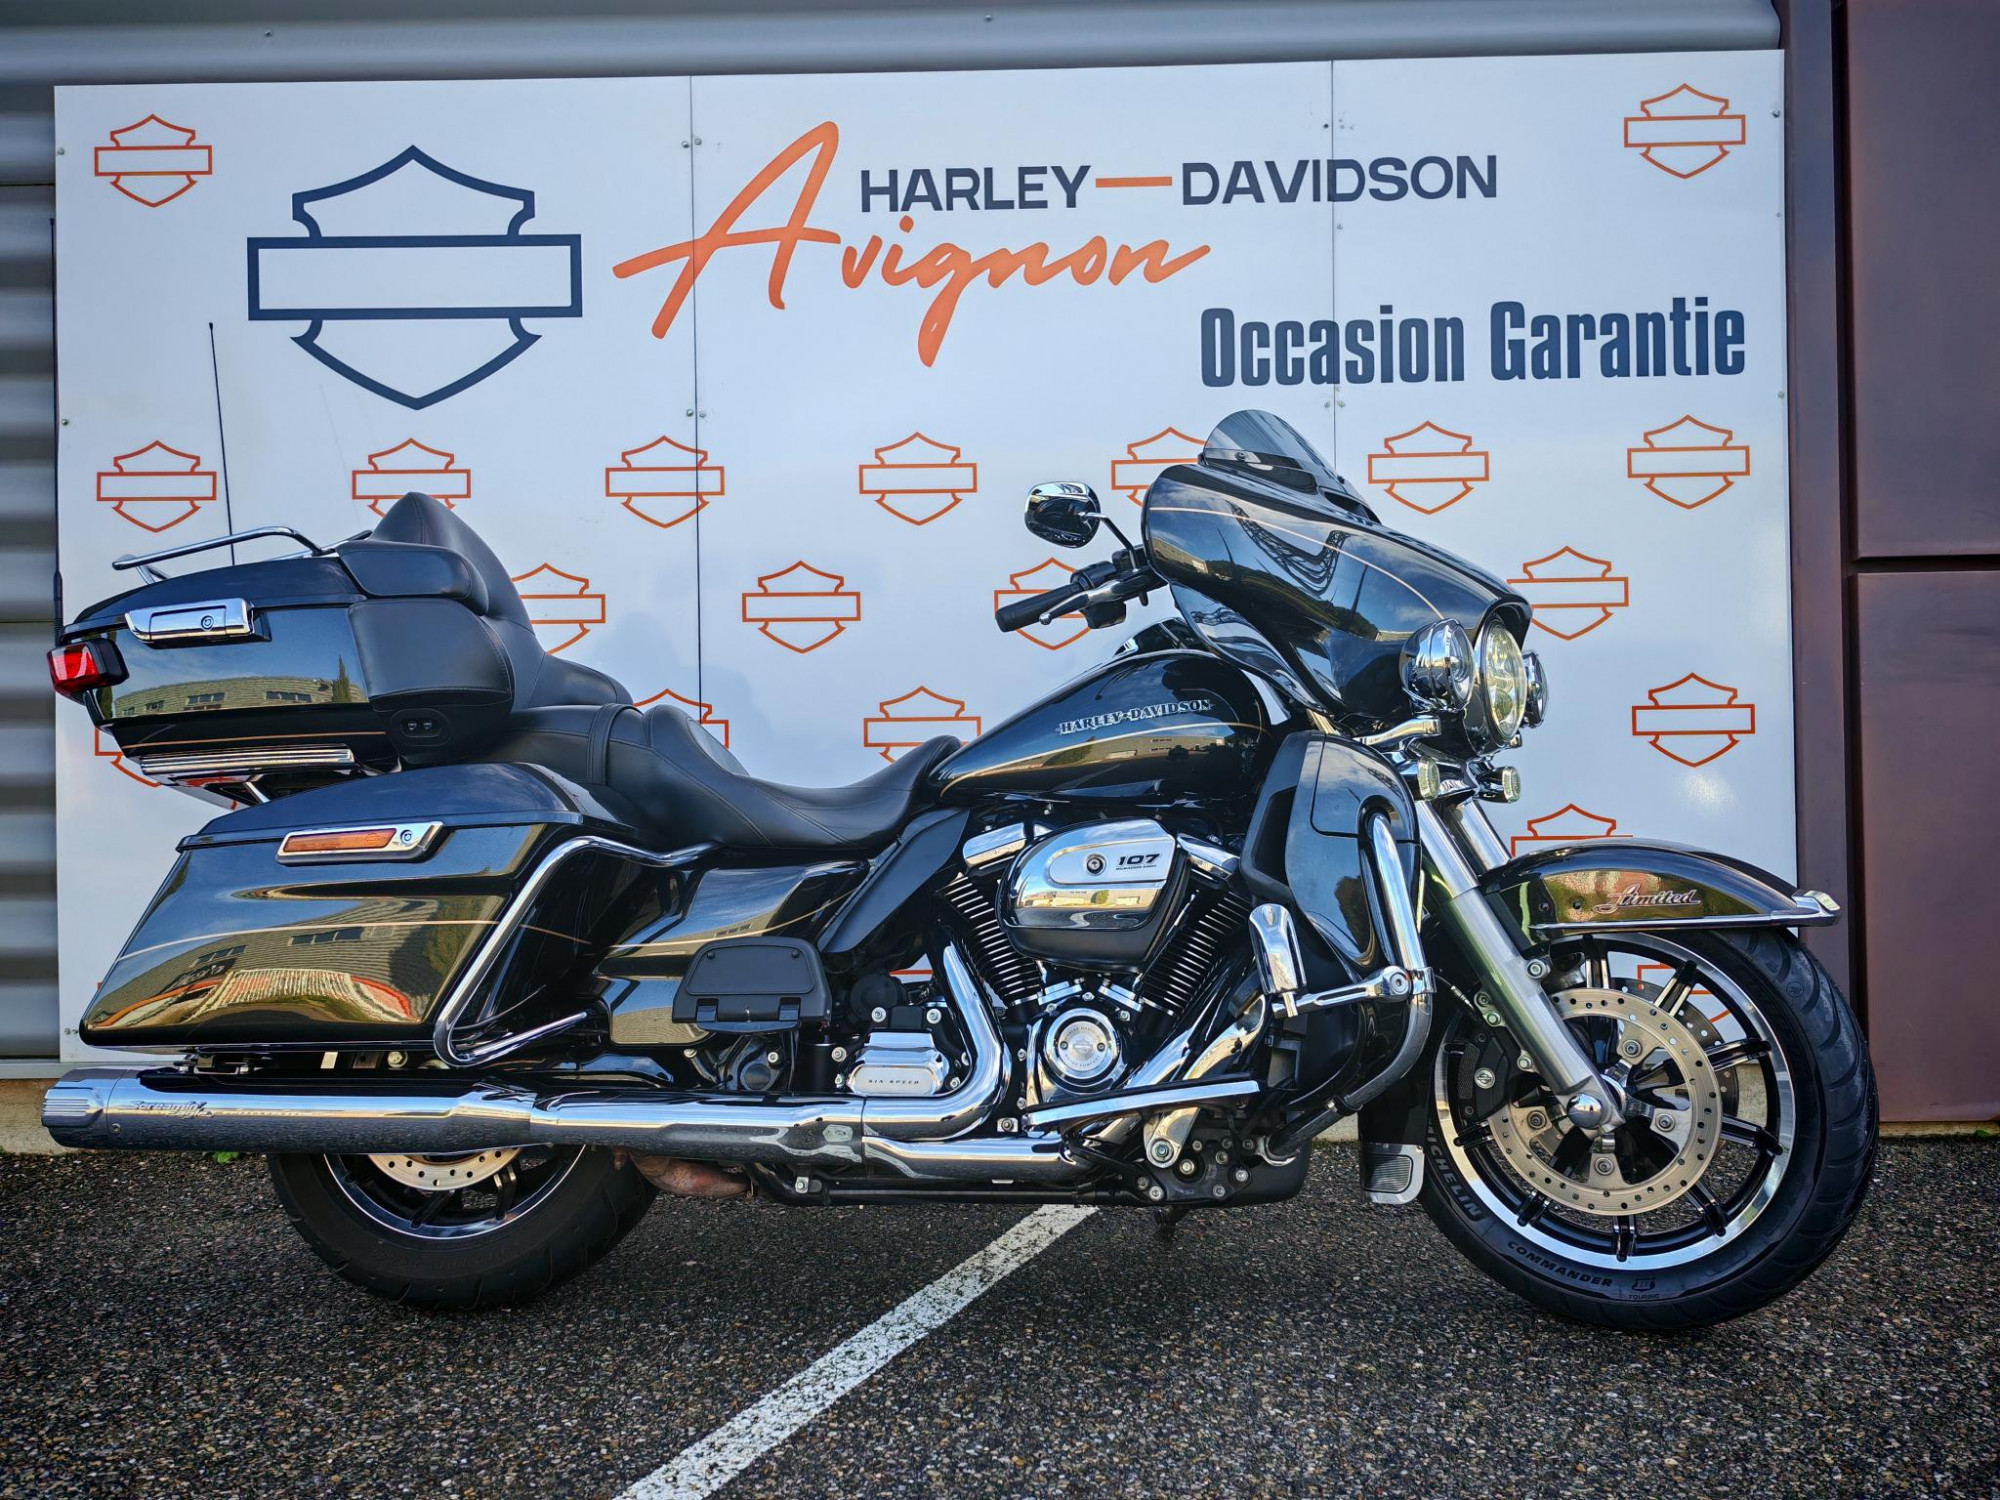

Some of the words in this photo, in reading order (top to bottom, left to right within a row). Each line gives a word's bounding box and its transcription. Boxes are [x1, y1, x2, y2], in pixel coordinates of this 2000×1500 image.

[612, 120, 1211, 367] Avignon
[1201, 304, 1465, 388] Occasion
[1490, 296, 1746, 381] Garantie
[1118, 853, 1160, 865] 107
[1592, 883, 1702, 914] Limited
[1507, 1241, 1613, 1287] COMMANDER
